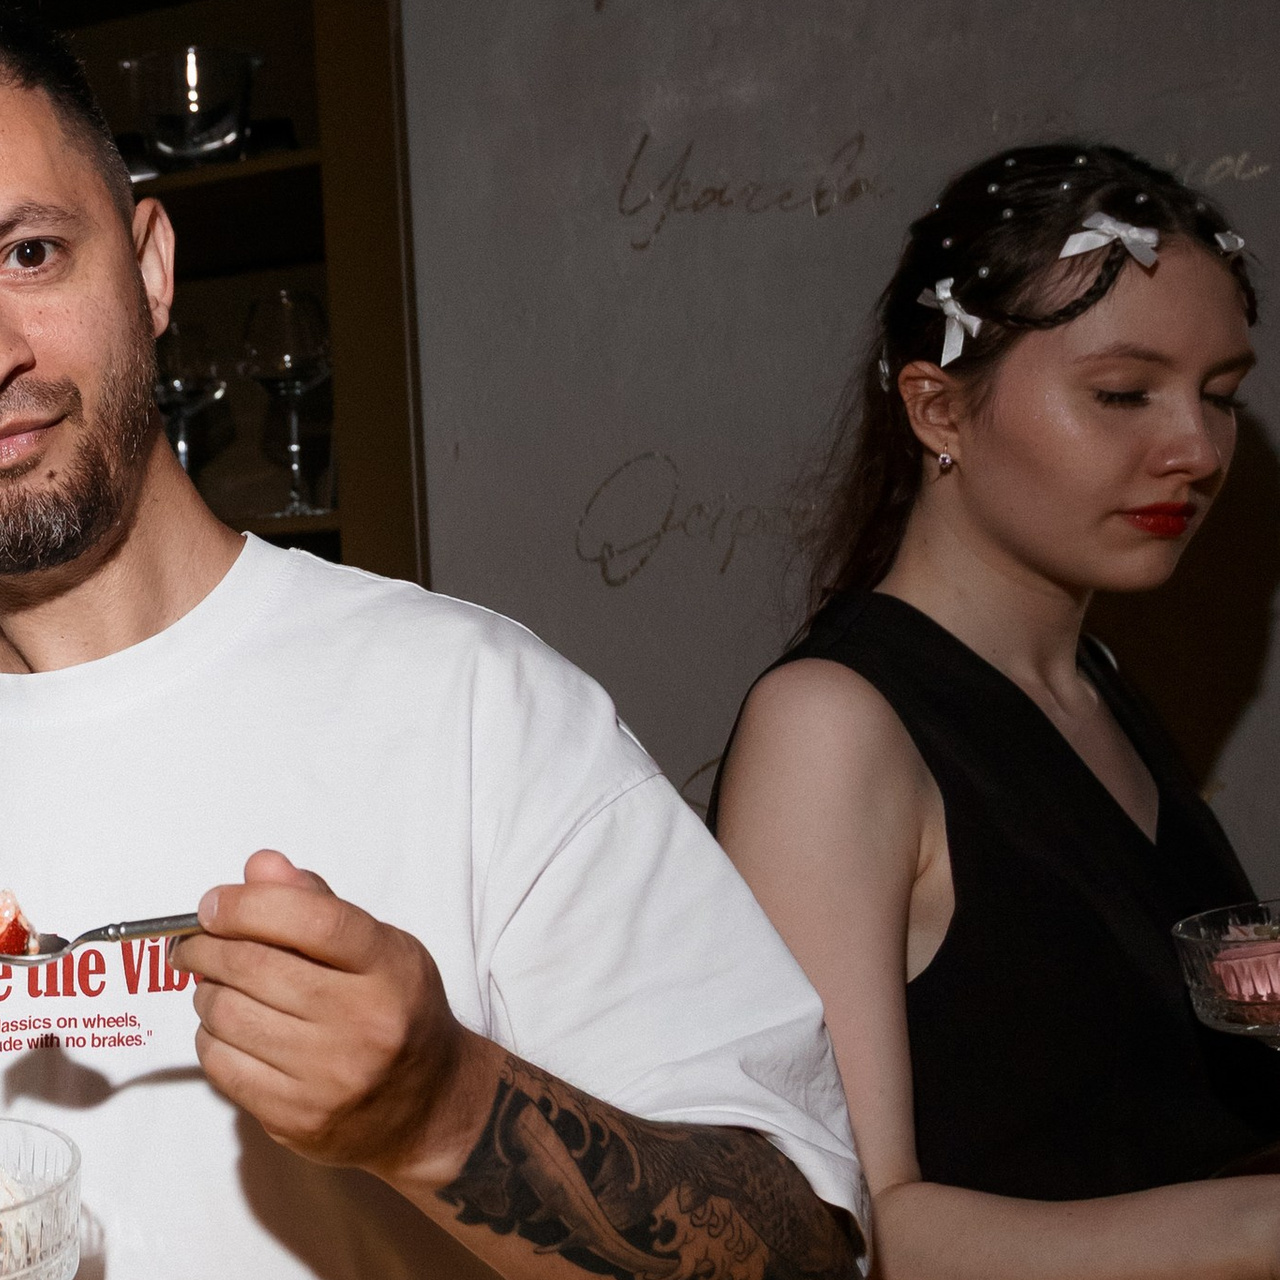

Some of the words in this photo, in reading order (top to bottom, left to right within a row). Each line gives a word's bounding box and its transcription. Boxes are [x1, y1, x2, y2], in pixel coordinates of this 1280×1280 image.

[27, 949, 107, 998] the
[56, 1017, 78, 1029] on
[82, 1012, 141, 1030] wheels,
[27, 1033, 60, 1050] with
[65, 1034, 86, 1048] no
[91, 1030, 153, 1048] brakes."
